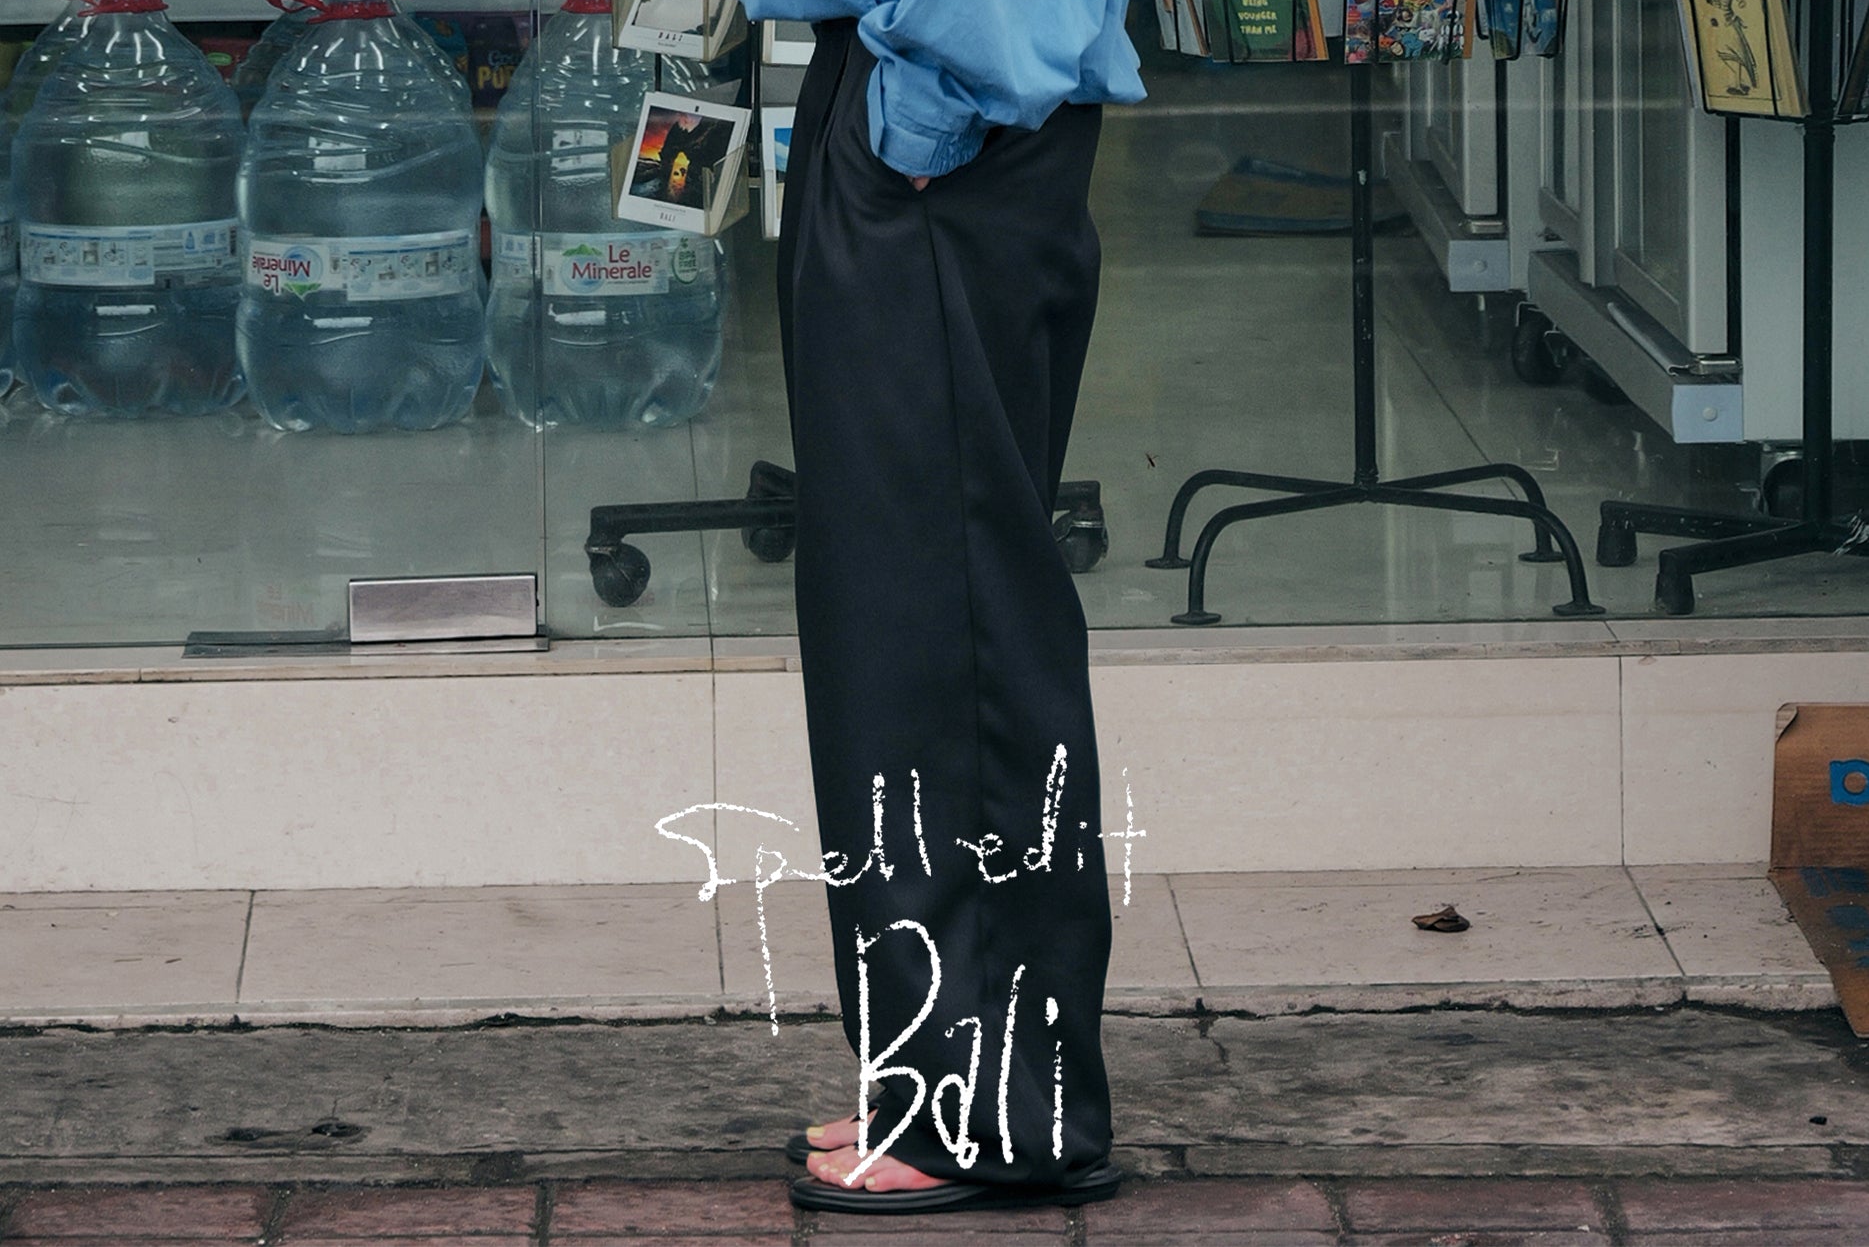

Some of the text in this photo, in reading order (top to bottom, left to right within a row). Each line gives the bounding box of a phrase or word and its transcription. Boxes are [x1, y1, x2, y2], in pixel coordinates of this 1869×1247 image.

[1237, 10, 1278, 21] YOUNGER
[1240, 24, 1278, 35] THAN ME
[608, 244, 631, 264] Le
[252, 255, 312, 278] Minerale
[571, 261, 653, 280] Minerale
[263, 274, 280, 294] Le
